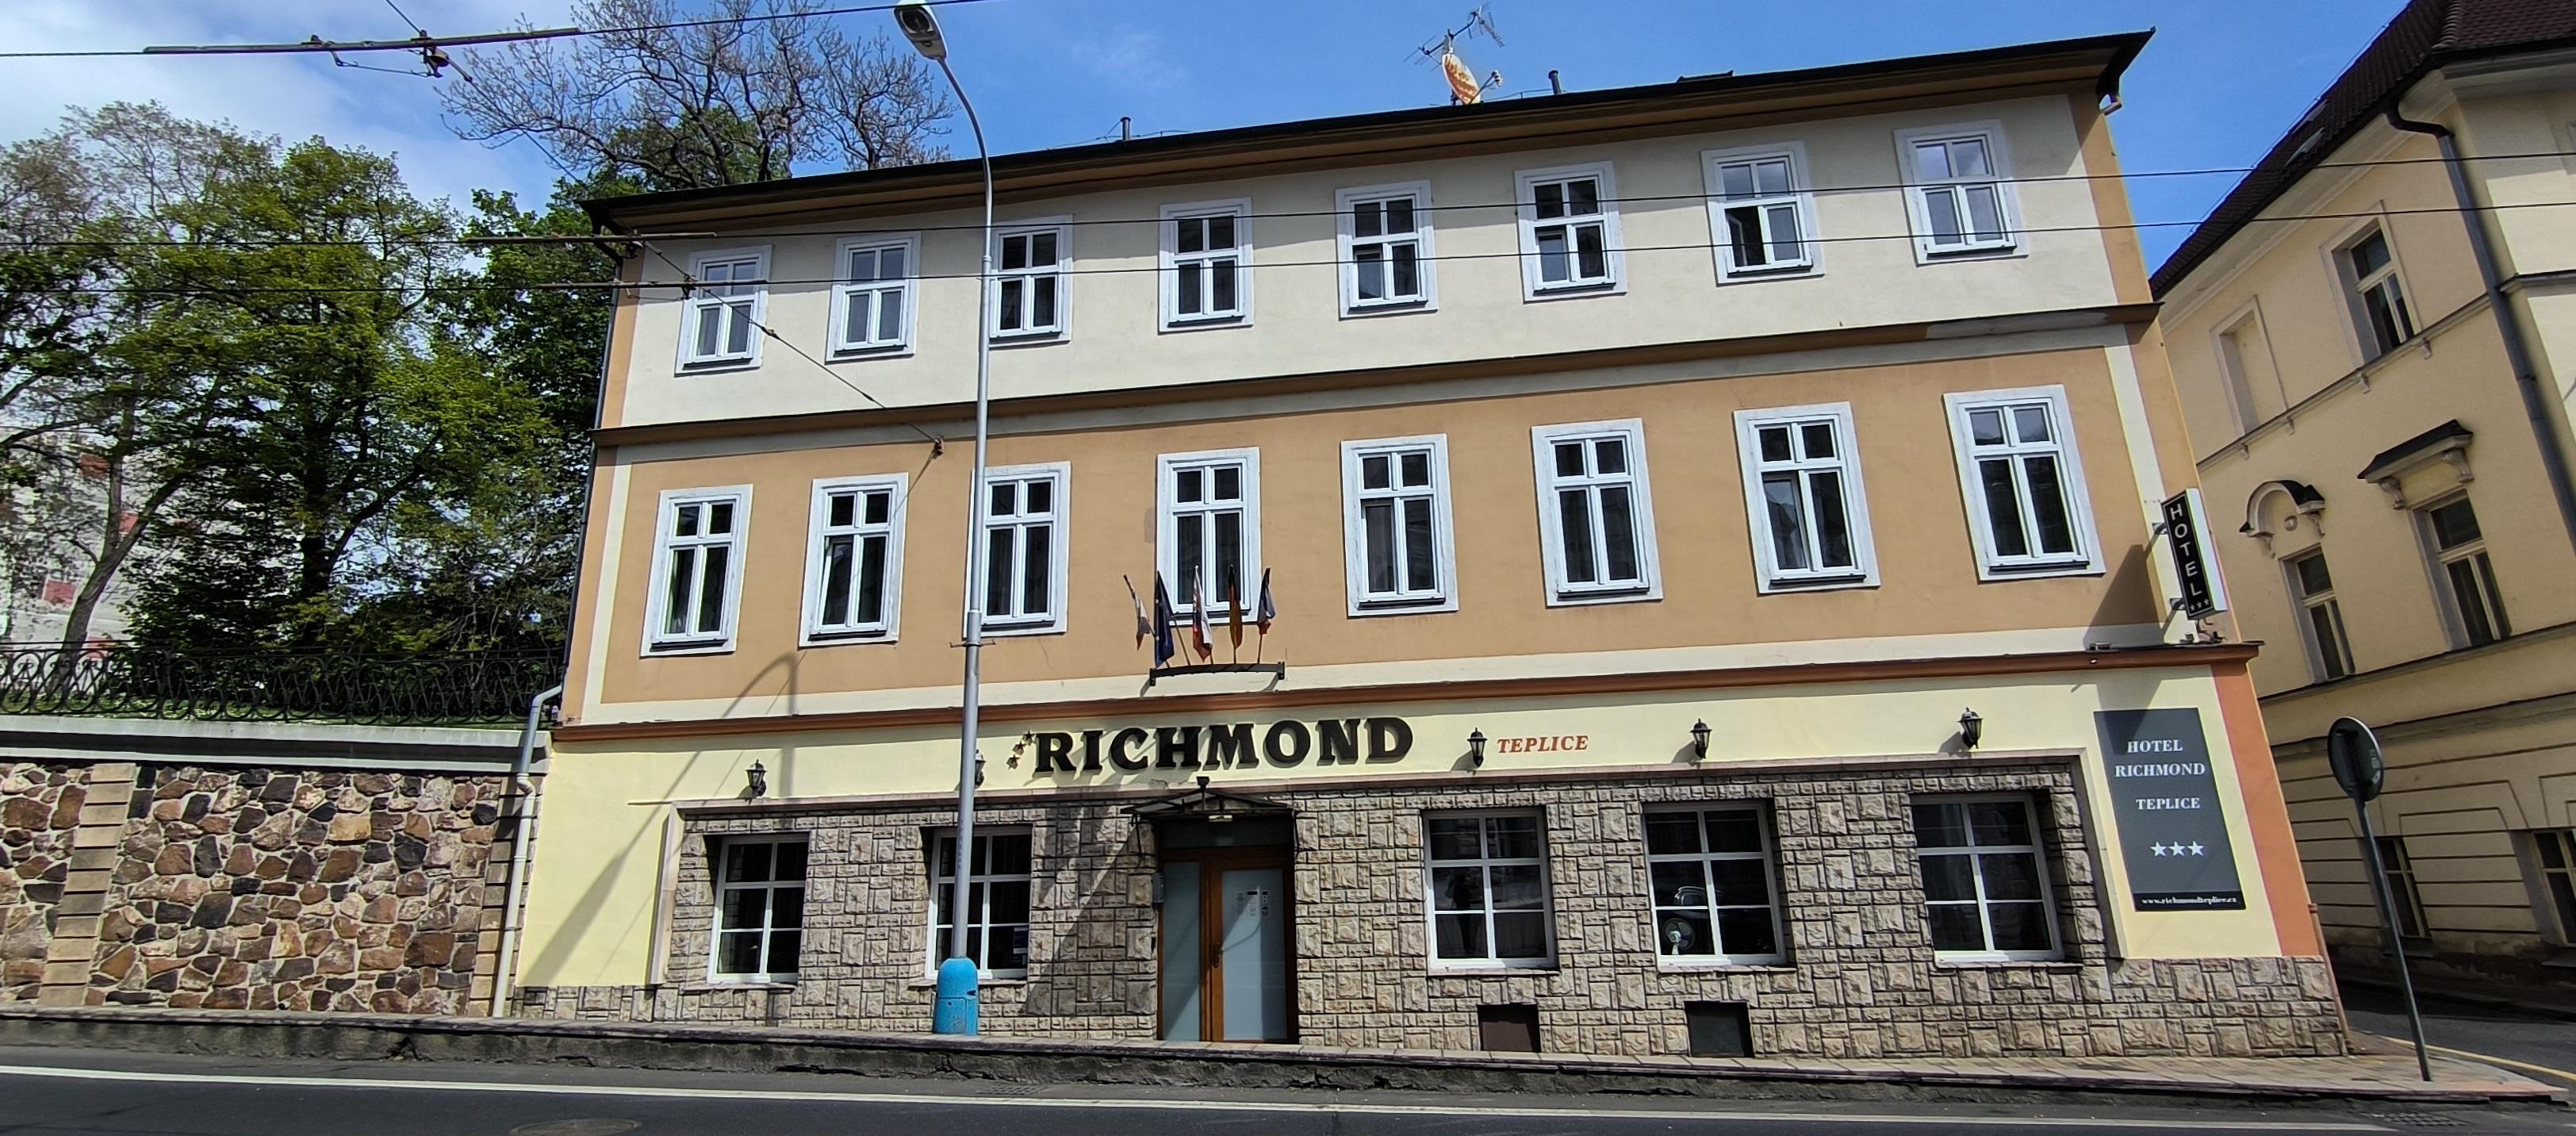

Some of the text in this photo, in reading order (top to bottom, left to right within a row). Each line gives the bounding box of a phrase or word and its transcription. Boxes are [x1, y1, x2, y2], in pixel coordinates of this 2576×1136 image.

[2170, 503, 2202, 597] HOTEL
[1033, 716, 1414, 776] RICHMOND
[1497, 735, 1589, 754] TEPLICE
[2126, 739, 2183, 754] HOTEL
[2114, 762, 2206, 777] RICHMOND
[2135, 797, 2201, 810] TEPLICE
